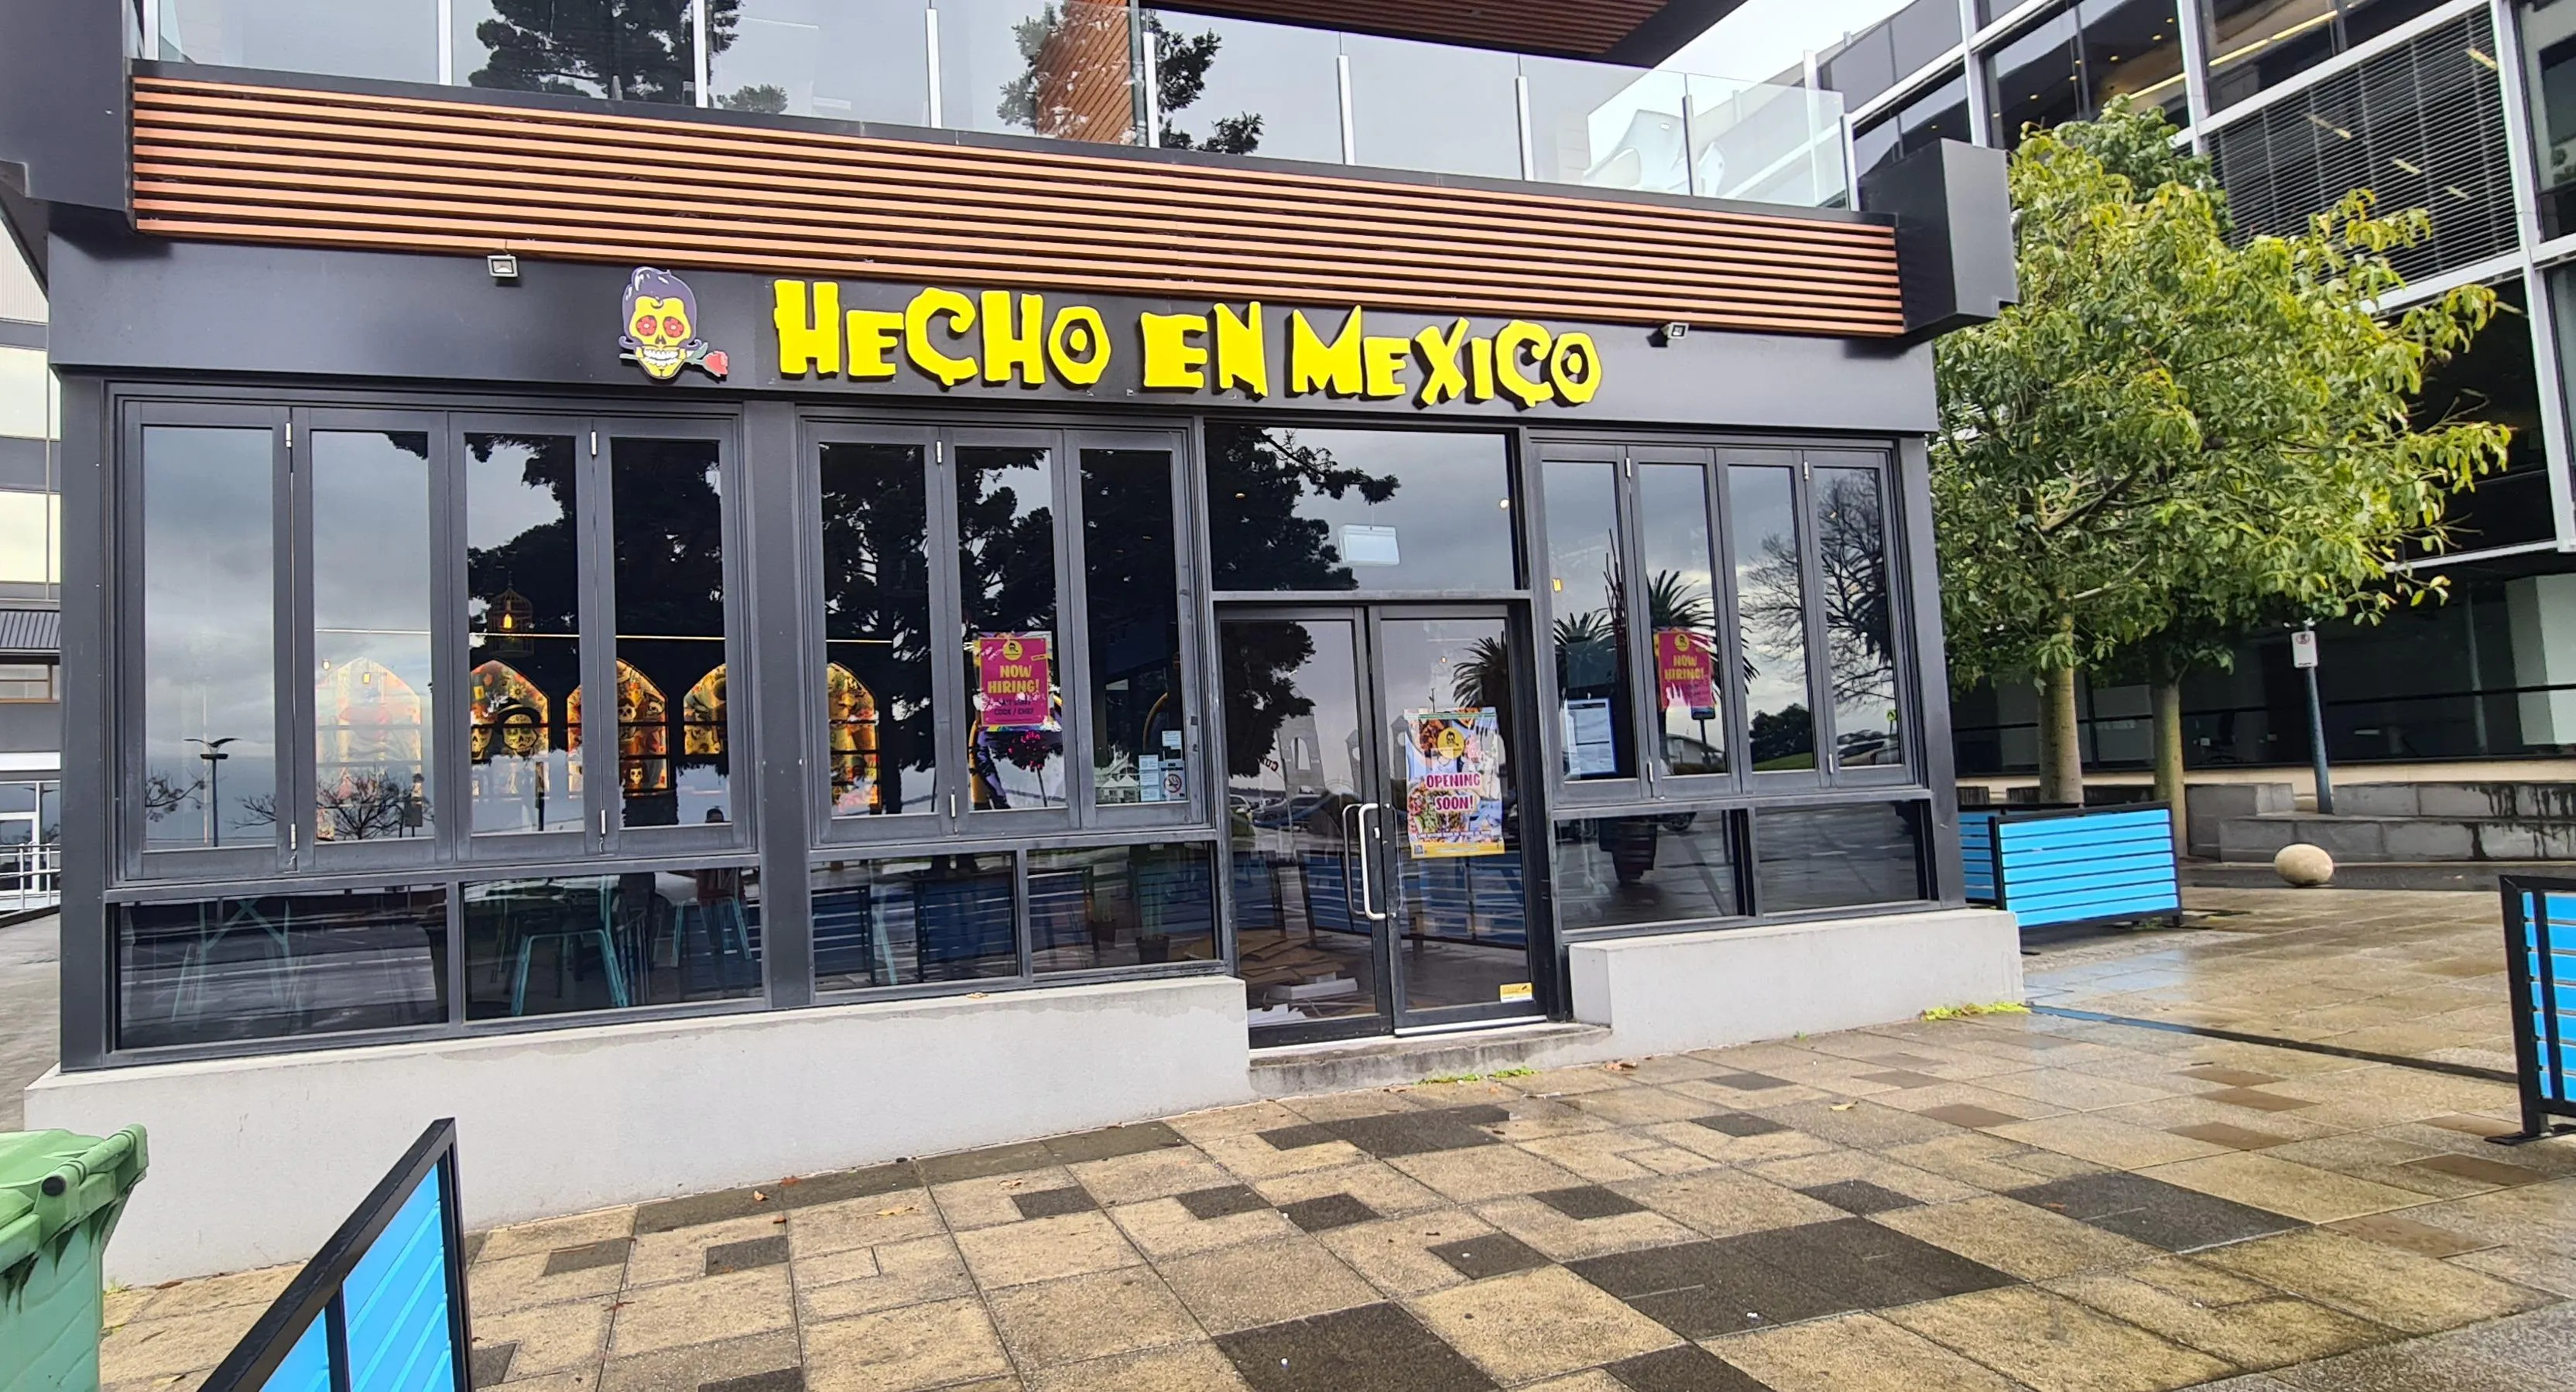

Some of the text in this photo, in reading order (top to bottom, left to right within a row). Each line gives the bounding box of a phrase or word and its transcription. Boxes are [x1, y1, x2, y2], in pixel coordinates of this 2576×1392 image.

[773, 279, 1603, 408] HECHO EN MEXICO
[1673, 655, 1697, 666] NOW
[999, 664, 1033, 678] NOW
[987, 679, 1041, 694] HIRING!
[1426, 774, 1481, 788] OPENING
[1434, 796, 1475, 812] SOON!
